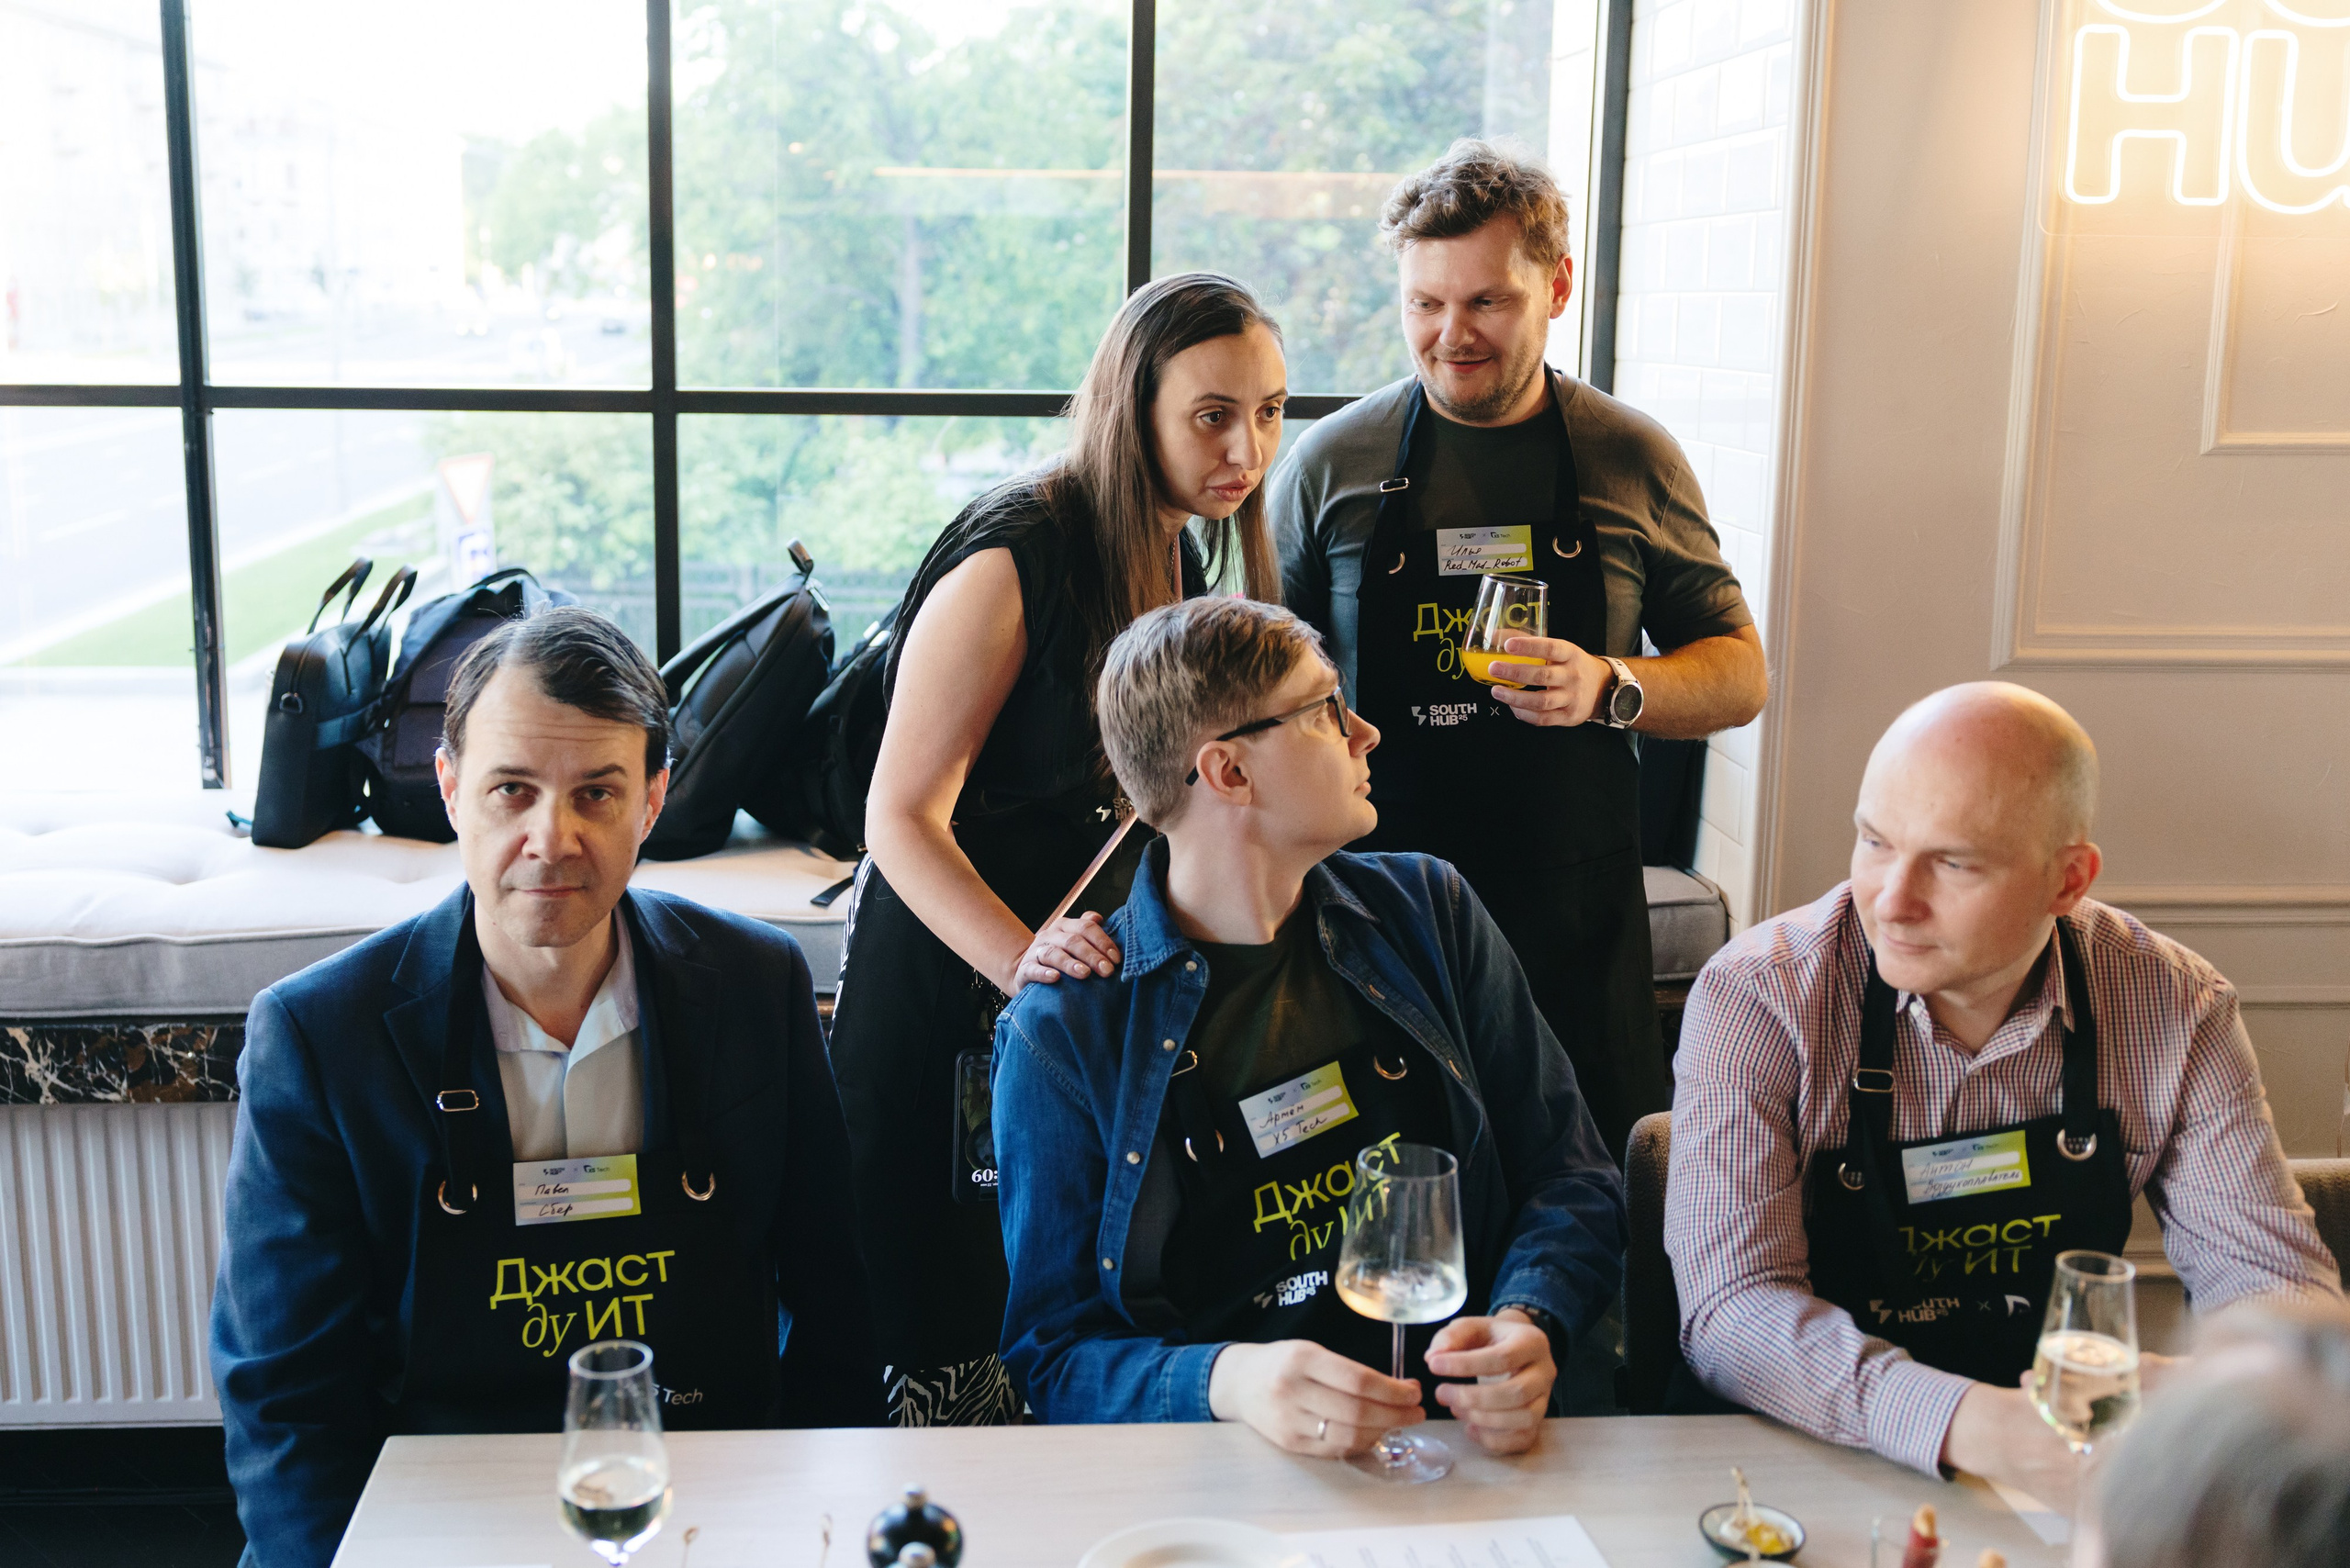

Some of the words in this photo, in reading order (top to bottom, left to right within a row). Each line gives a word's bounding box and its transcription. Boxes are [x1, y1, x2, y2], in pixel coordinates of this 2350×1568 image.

[1429, 702, 1478, 717] SOUTH
[1295, 1117, 1328, 1135] Tech
[535, 1183, 569, 1196] Павел
[539, 1204, 573, 1216] Сбер
[489, 1250, 676, 1310] Джаст
[1276, 1271, 1328, 1294] SOUTH
[521, 1303, 577, 1358] ду
[586, 1294, 654, 1340] ИТ
[662, 1388, 703, 1406] Tech
